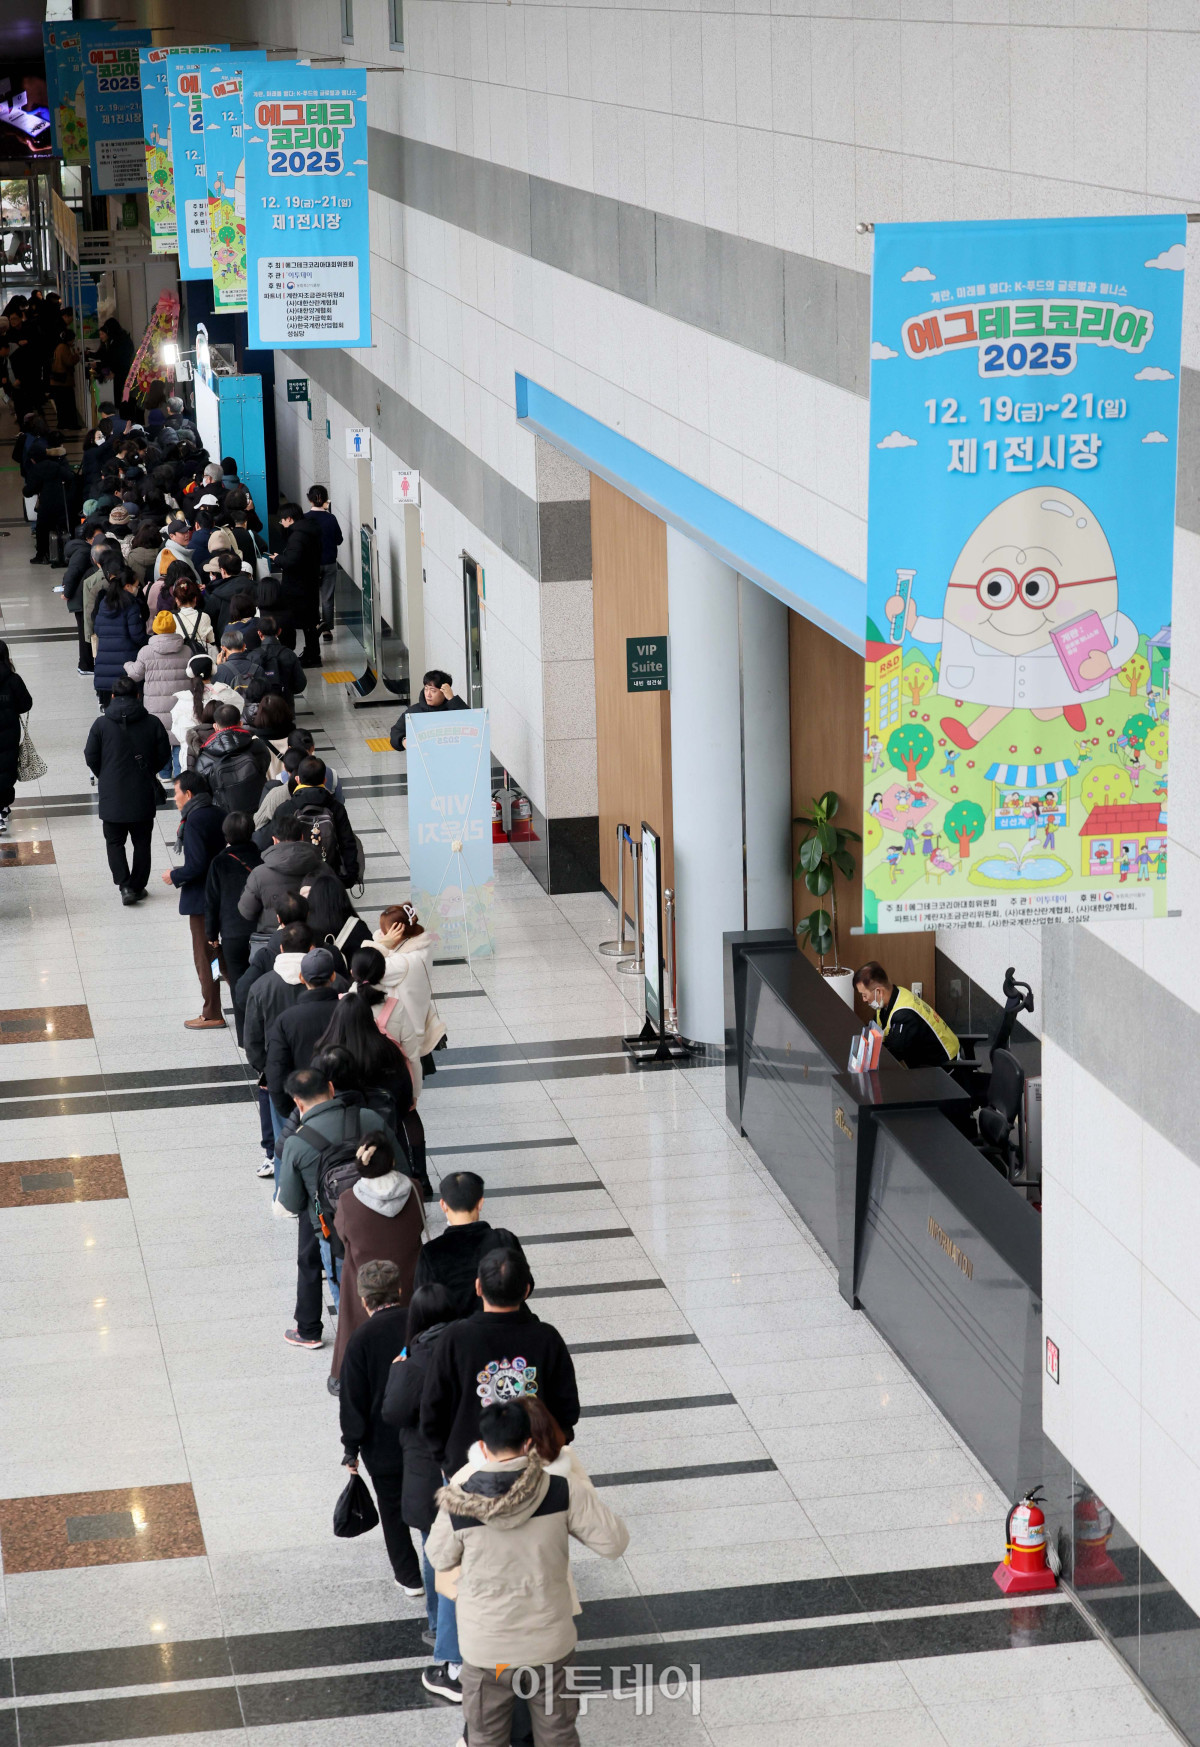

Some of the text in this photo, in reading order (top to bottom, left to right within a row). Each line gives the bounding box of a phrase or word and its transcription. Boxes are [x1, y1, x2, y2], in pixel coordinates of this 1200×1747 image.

[99, 77, 140, 91] 2025
[258, 103, 353, 126] 에그테크
[270, 127, 342, 150] 코리아
[271, 151, 341, 173] 2025
[261, 197, 281, 208] 12.
[271, 213, 342, 230] 제1전시장
[930, 280, 1128, 303] 계란, 미래를 열다: K-푸드의 글로벌과 웰니스
[907, 305, 1148, 354] 에그테크코리아
[984, 342, 1072, 372] 2025
[924, 393, 1127, 424] 12. 19(금)~21(일)
[947, 433, 1102, 474] 제1전시장
[636, 644, 657, 656] VIP
[631, 660, 663, 673] Suite
[880, 655, 900, 673] R&D
[894, 914, 917, 923] 파트너
[928, 1215, 974, 1281] INFORMATION
